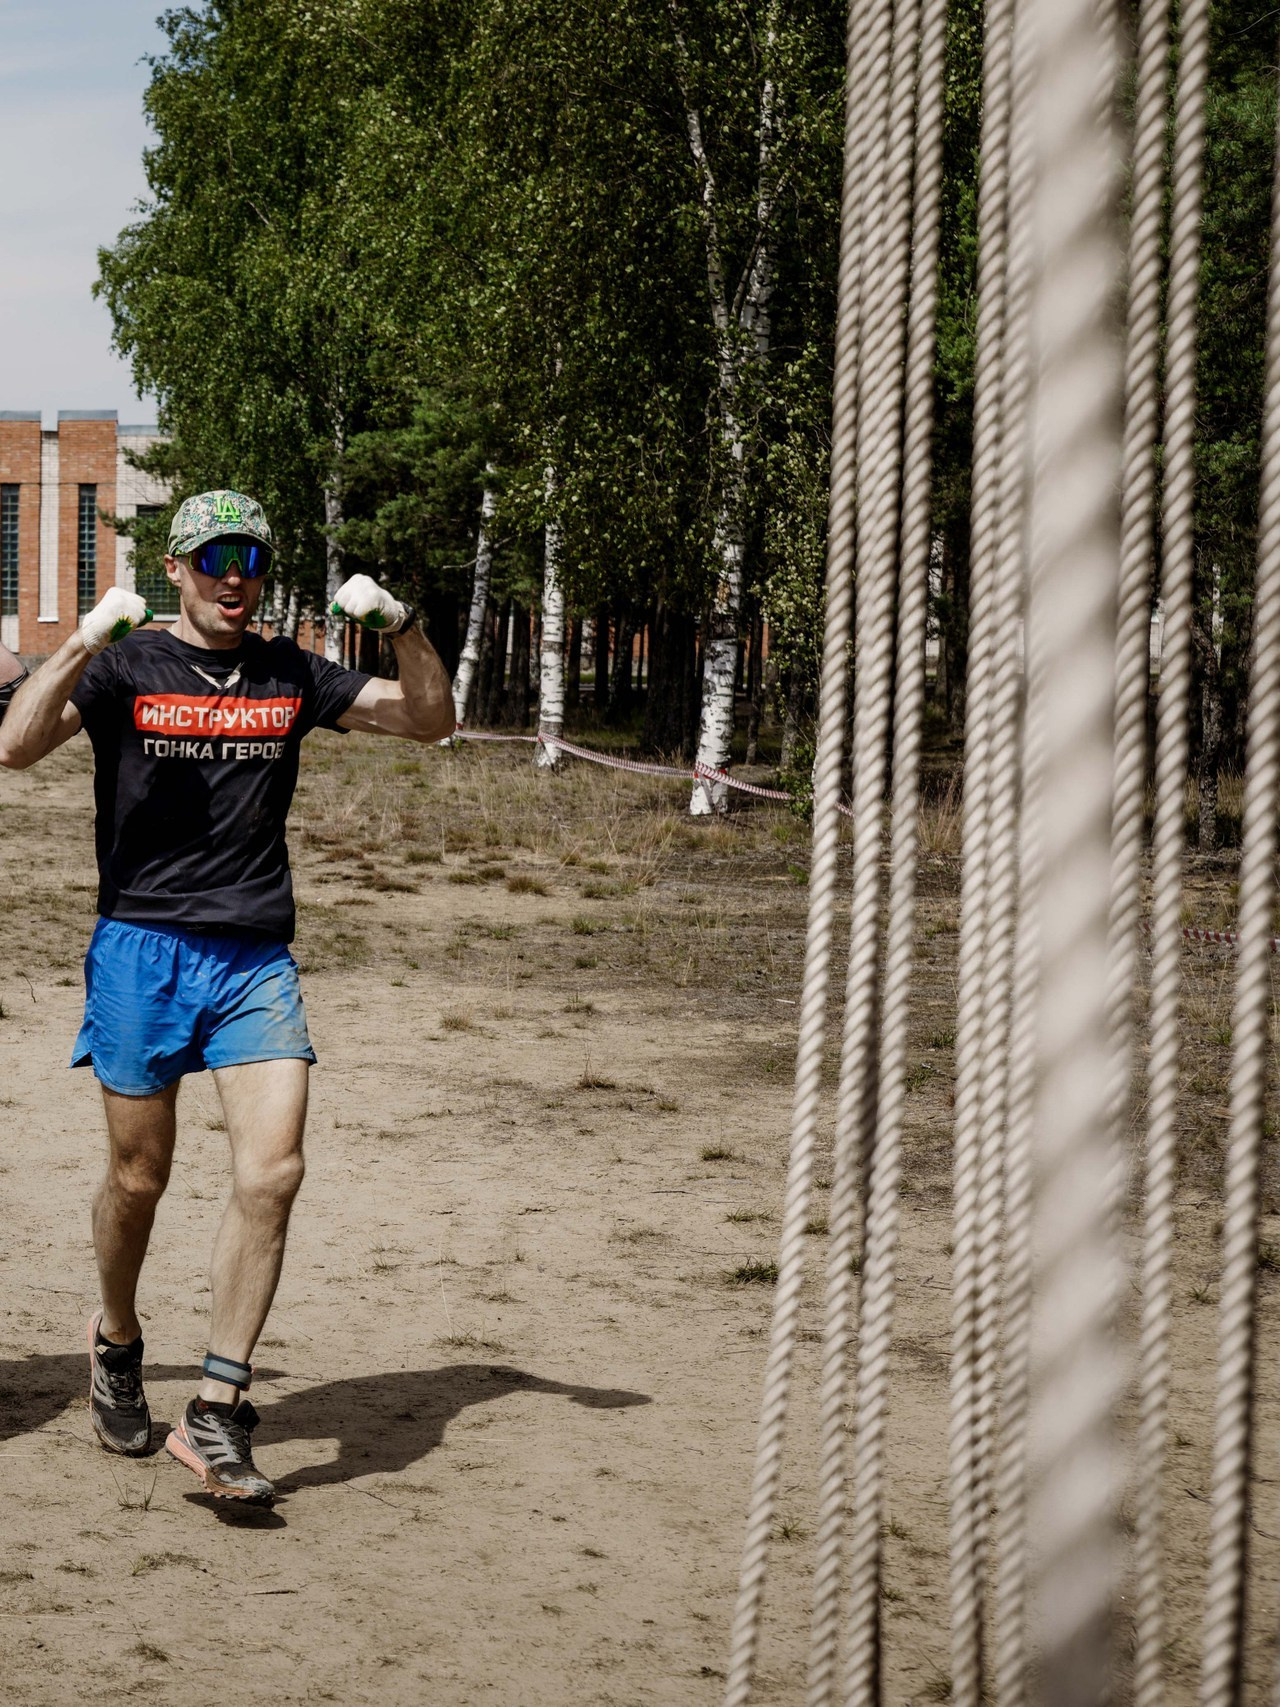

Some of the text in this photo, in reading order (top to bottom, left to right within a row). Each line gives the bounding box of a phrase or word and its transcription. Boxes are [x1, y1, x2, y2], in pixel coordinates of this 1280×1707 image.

[215, 496, 241, 522] LA
[142, 704, 295, 729] ИНСТРУКТОР
[144, 738, 214, 760] ГОНКА
